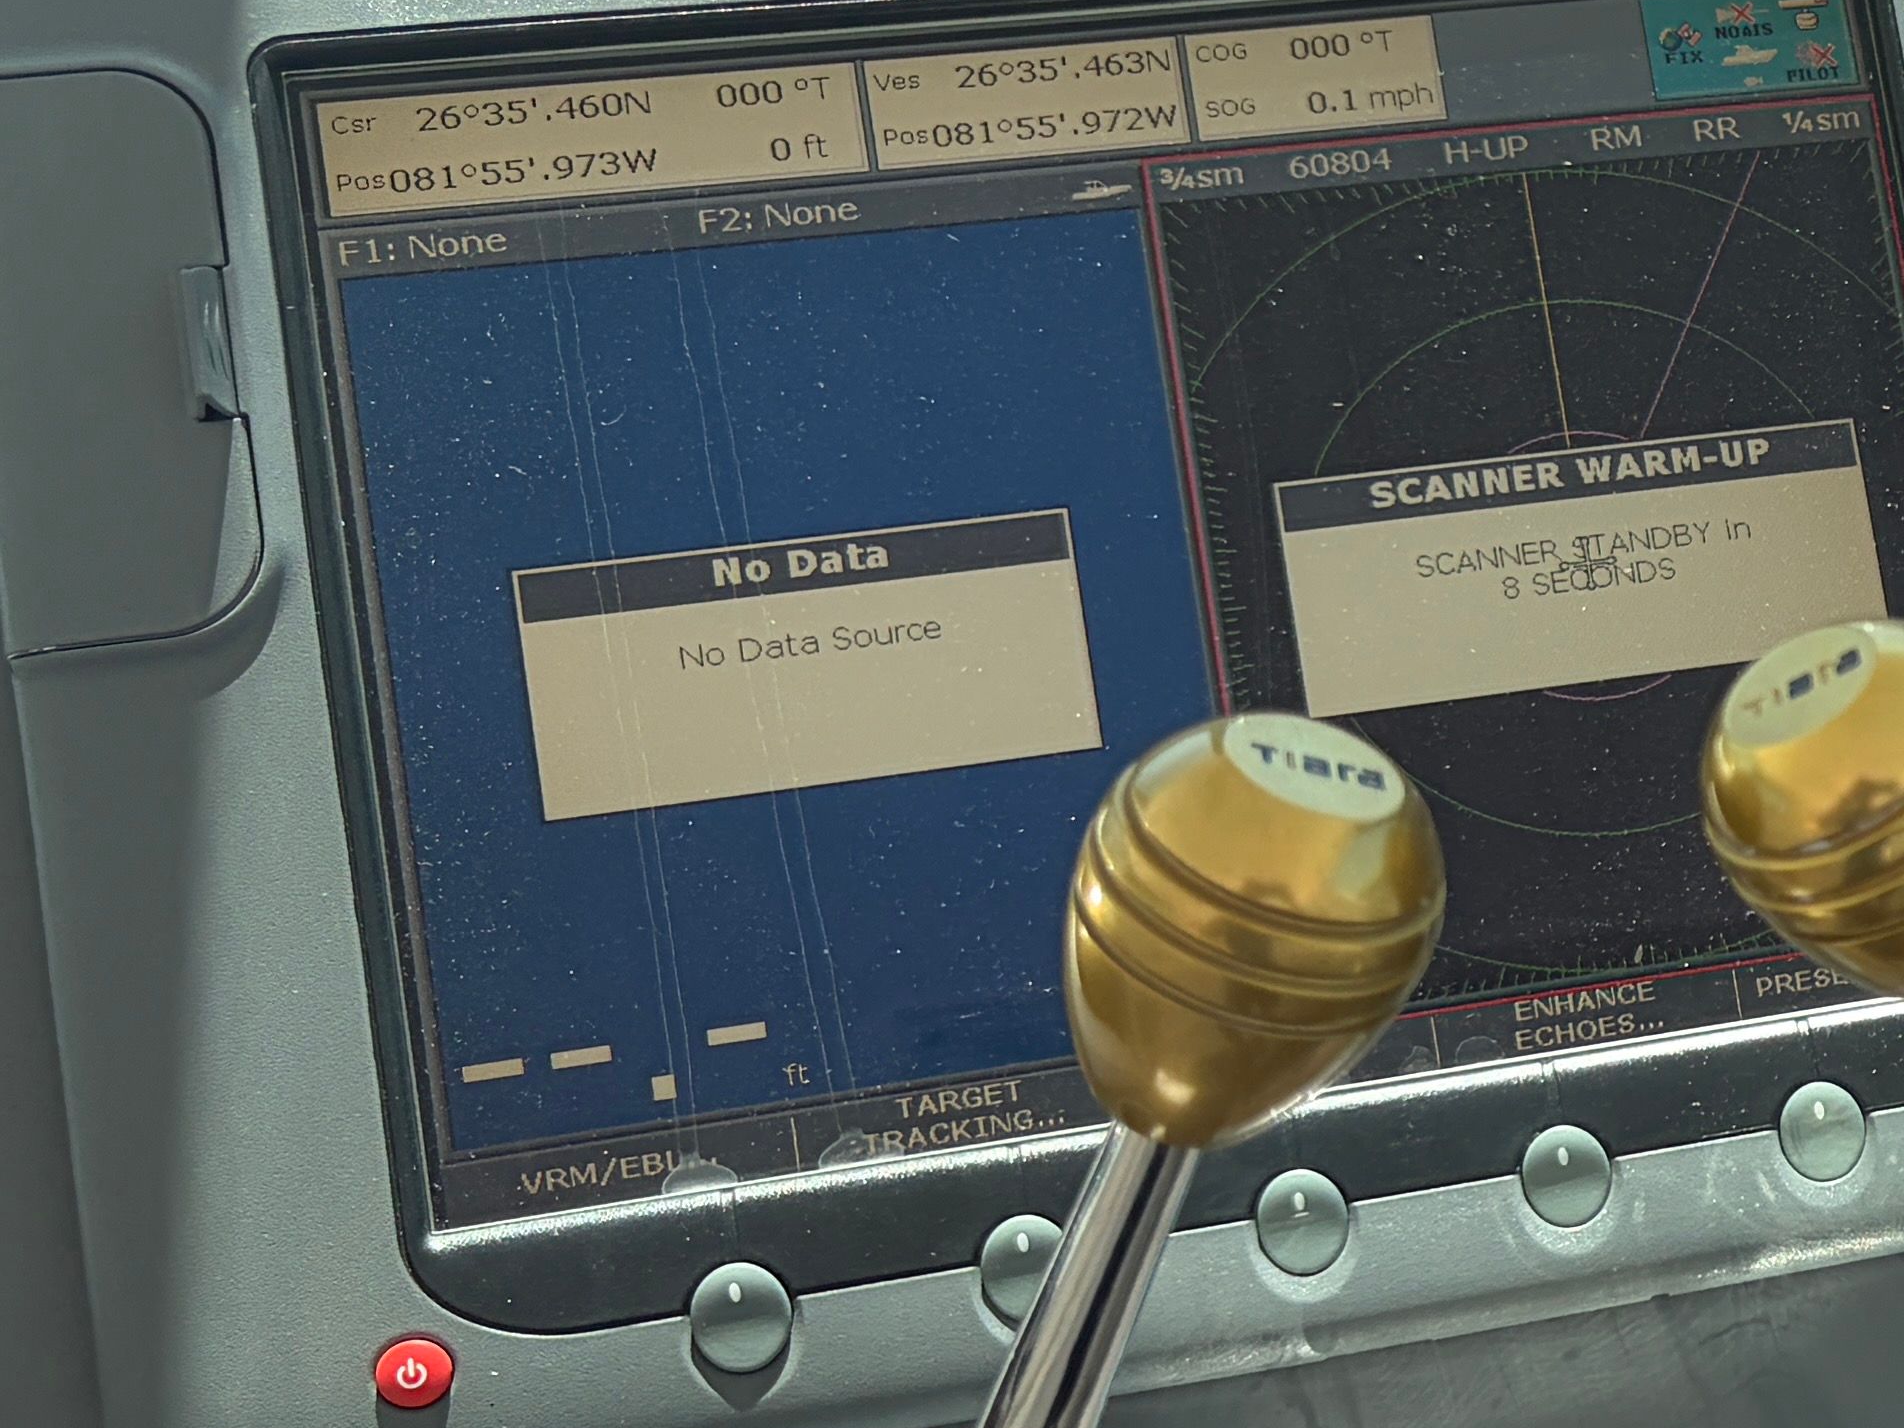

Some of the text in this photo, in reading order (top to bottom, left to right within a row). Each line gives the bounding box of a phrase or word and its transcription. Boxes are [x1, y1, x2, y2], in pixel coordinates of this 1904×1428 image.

[1195, 34, 1350, 64] COG 000
[874, 74, 921, 93] Ves
[1206, 84, 1434, 118] SOG 0.1 mph
[332, 115, 376, 136] Csr
[717, 81, 783, 108] 000
[884, 126, 929, 146] Pos
[1289, 116, 1741, 179] 60804 H-UP RM RR
[337, 172, 386, 192] Pos
[770, 138, 791, 161] 0
[804, 134, 829, 159] ft
[764, 199, 861, 228] None
[339, 230, 507, 267] F1: None
[1368, 438, 1771, 508] SCANNER WARM-UP
[711, 541, 890, 587] No Data
[1416, 518, 1751, 578] SCANNER STANDBY in
[1502, 559, 1676, 599] 8 SECONDS
[680, 617, 941, 669] No Data Source
[1514, 981, 1656, 1022] ENHANCE
[895, 1080, 1022, 1120] TARGET
